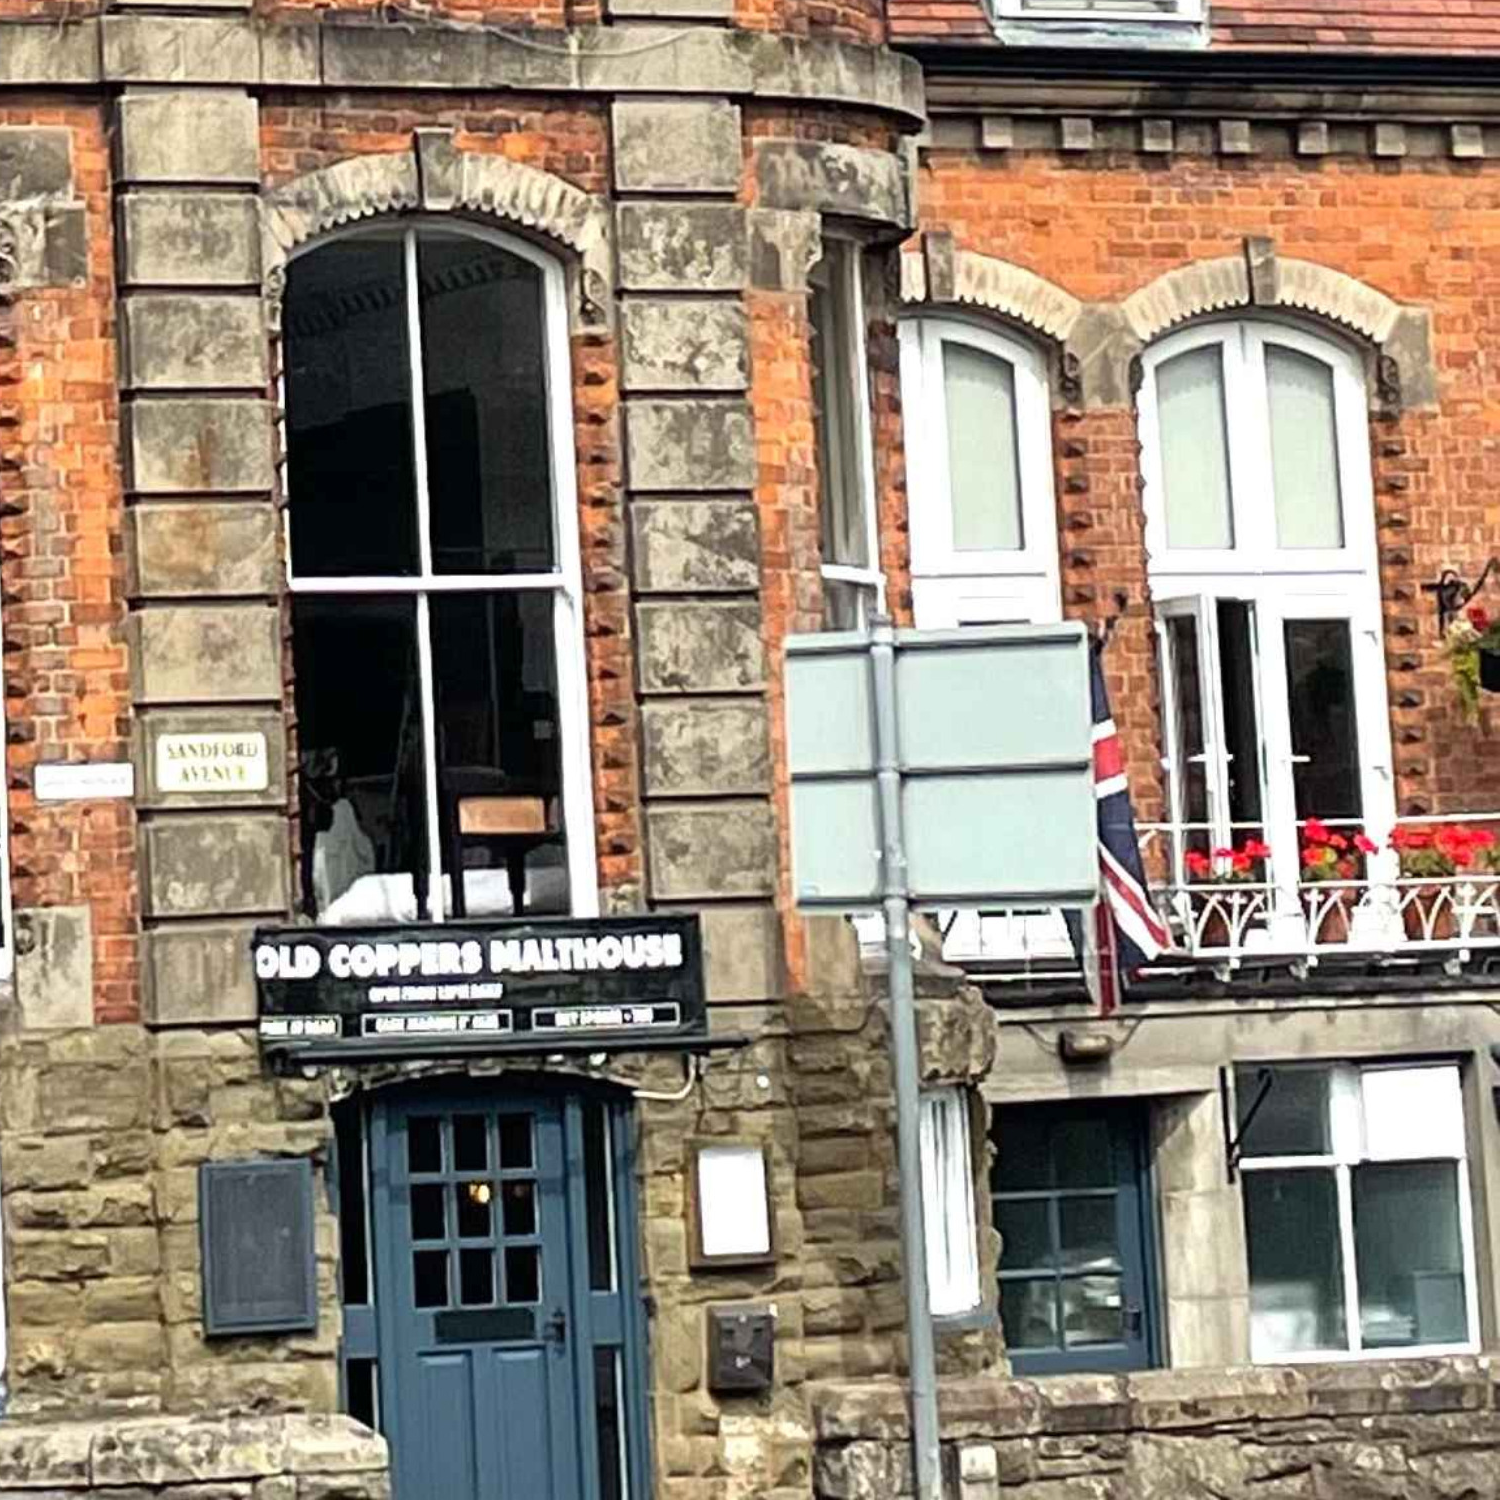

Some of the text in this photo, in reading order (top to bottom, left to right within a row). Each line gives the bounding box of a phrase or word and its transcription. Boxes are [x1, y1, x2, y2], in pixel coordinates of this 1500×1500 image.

[166, 741, 258, 760] SANDFORD
[179, 765, 245, 784] AVENUE
[255, 933, 683, 979] OLD COPPERS MALTHOUSE
